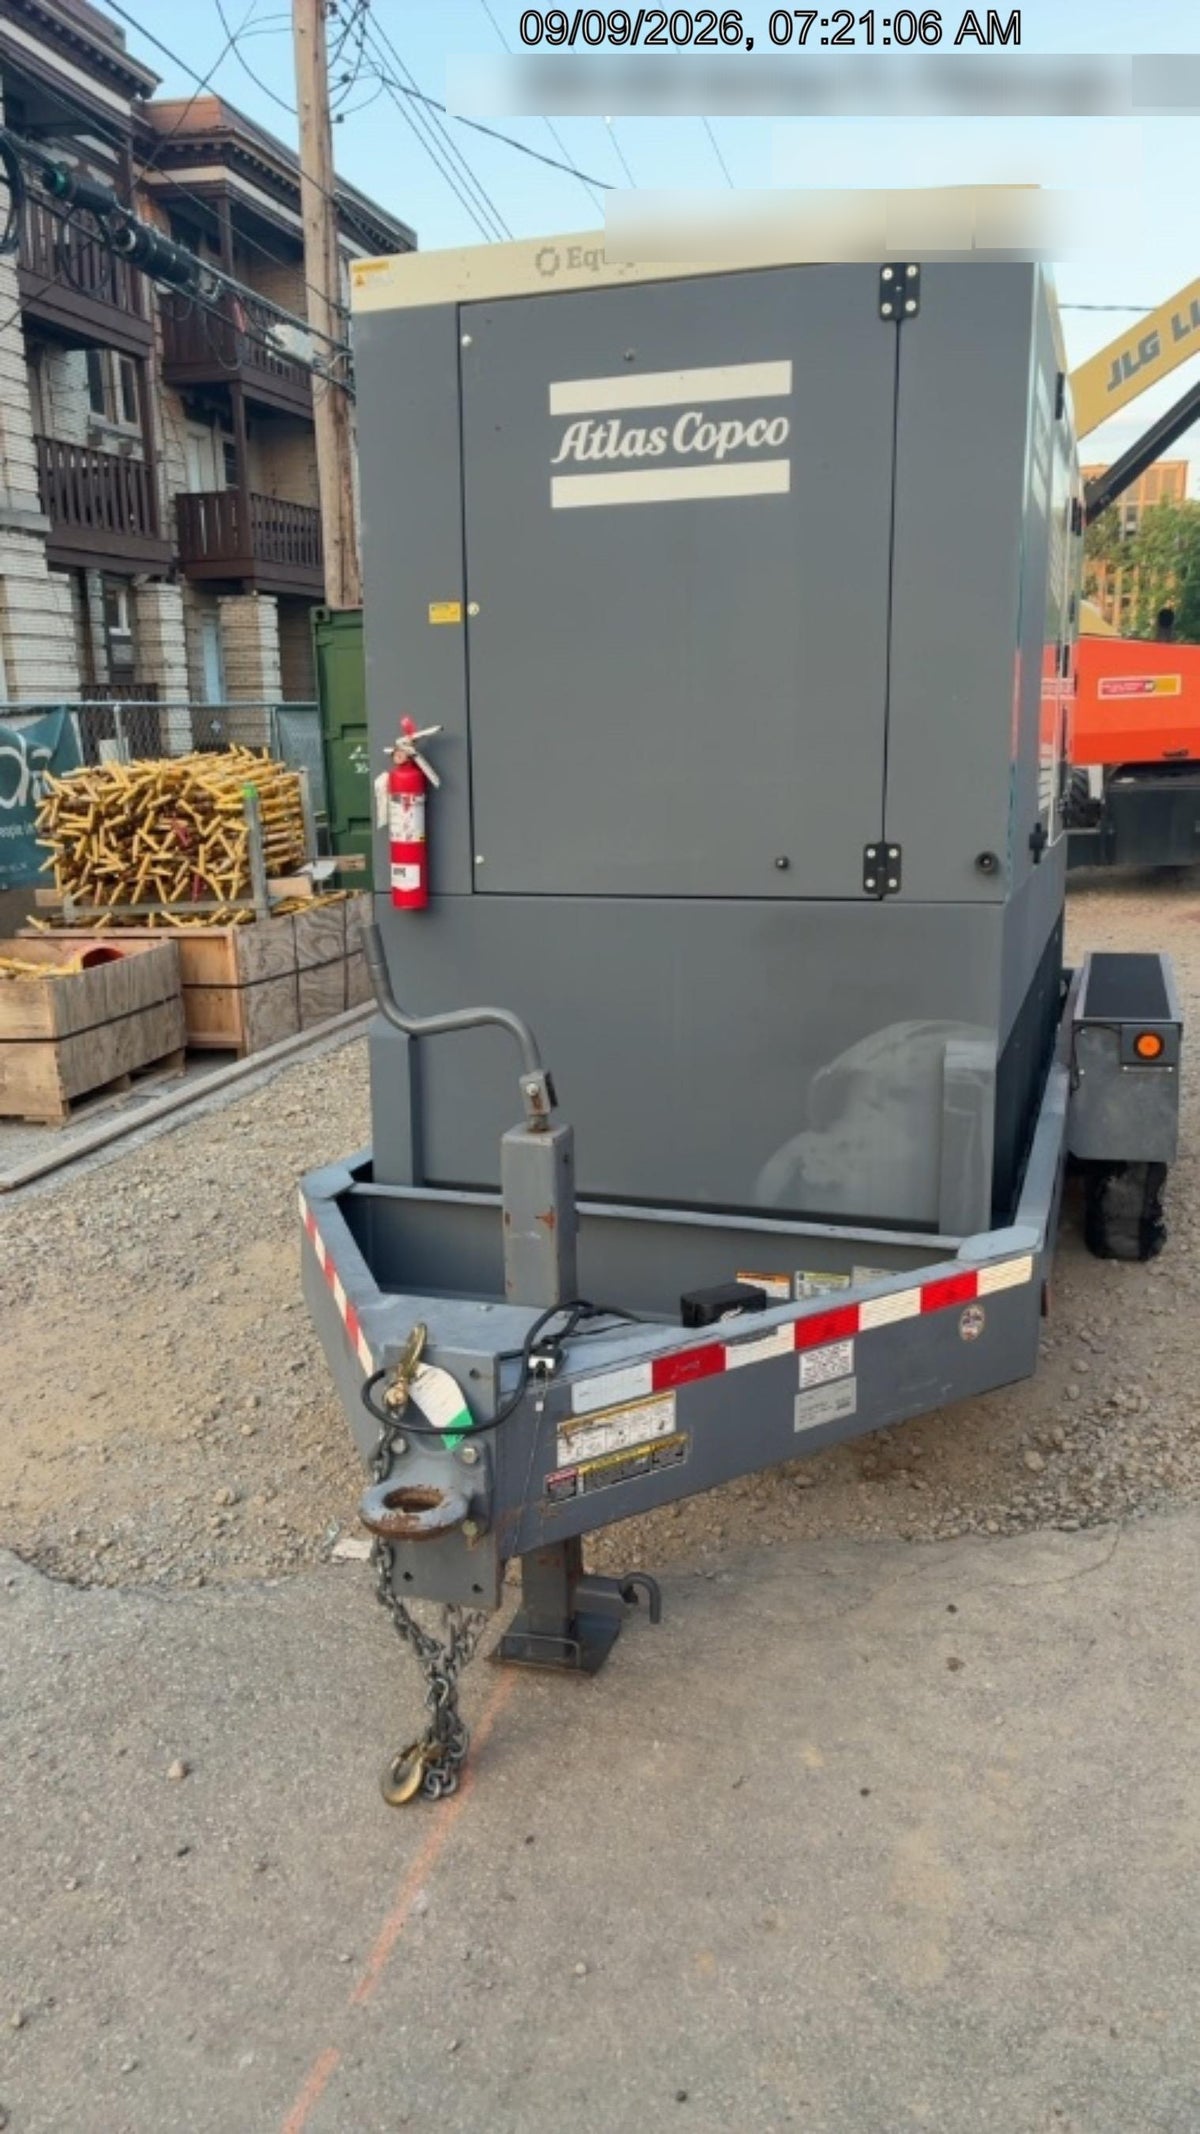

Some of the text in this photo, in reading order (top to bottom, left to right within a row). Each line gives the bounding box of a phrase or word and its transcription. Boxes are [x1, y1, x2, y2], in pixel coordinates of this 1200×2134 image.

[1107, 329, 1161, 392] JLG
[550, 411, 789, 464] Atlas Copco
